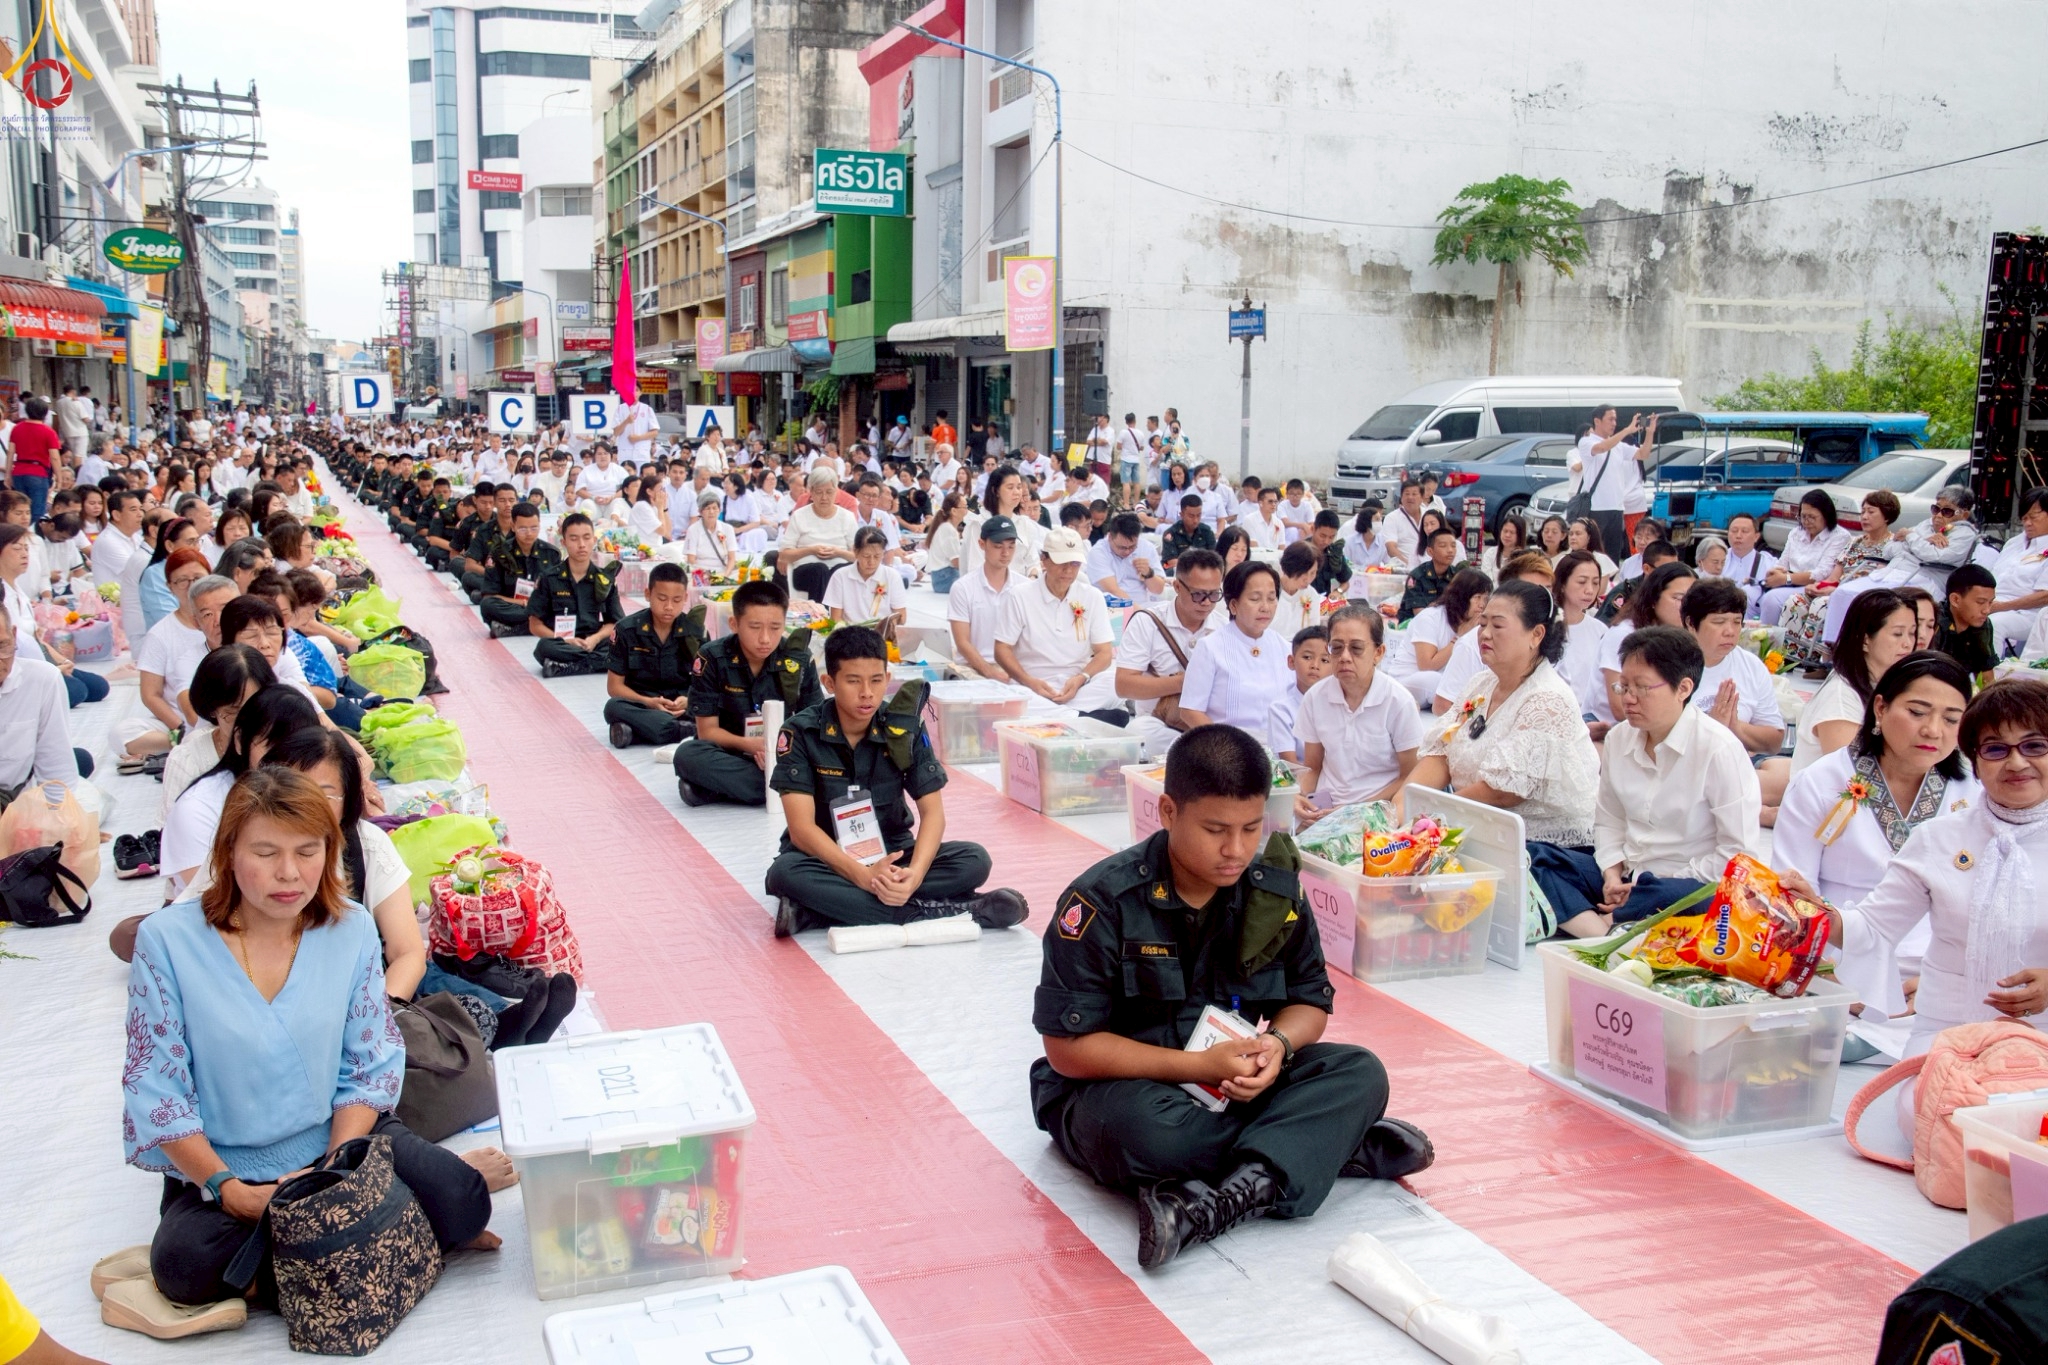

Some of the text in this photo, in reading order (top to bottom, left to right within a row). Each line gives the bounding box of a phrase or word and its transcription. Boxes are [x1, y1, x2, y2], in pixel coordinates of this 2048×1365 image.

[818, 154, 904, 191] ศรีวิไล
[558, 302, 589, 319] ถ่ายรูป
[354, 378, 380, 408] D
[500, 397, 522, 429] C
[584, 400, 607, 430] B
[697, 408, 719, 437] A
[1016, 753, 1030, 771] C72
[1143, 799, 1159, 822] C71
[1370, 839, 1411, 858] Ovaltine
[1312, 888, 1338, 915] C70
[1713, 903, 1731, 956] Ovaltine
[1595, 1003, 1633, 1036] C69
[598, 1065, 640, 1100] D211
